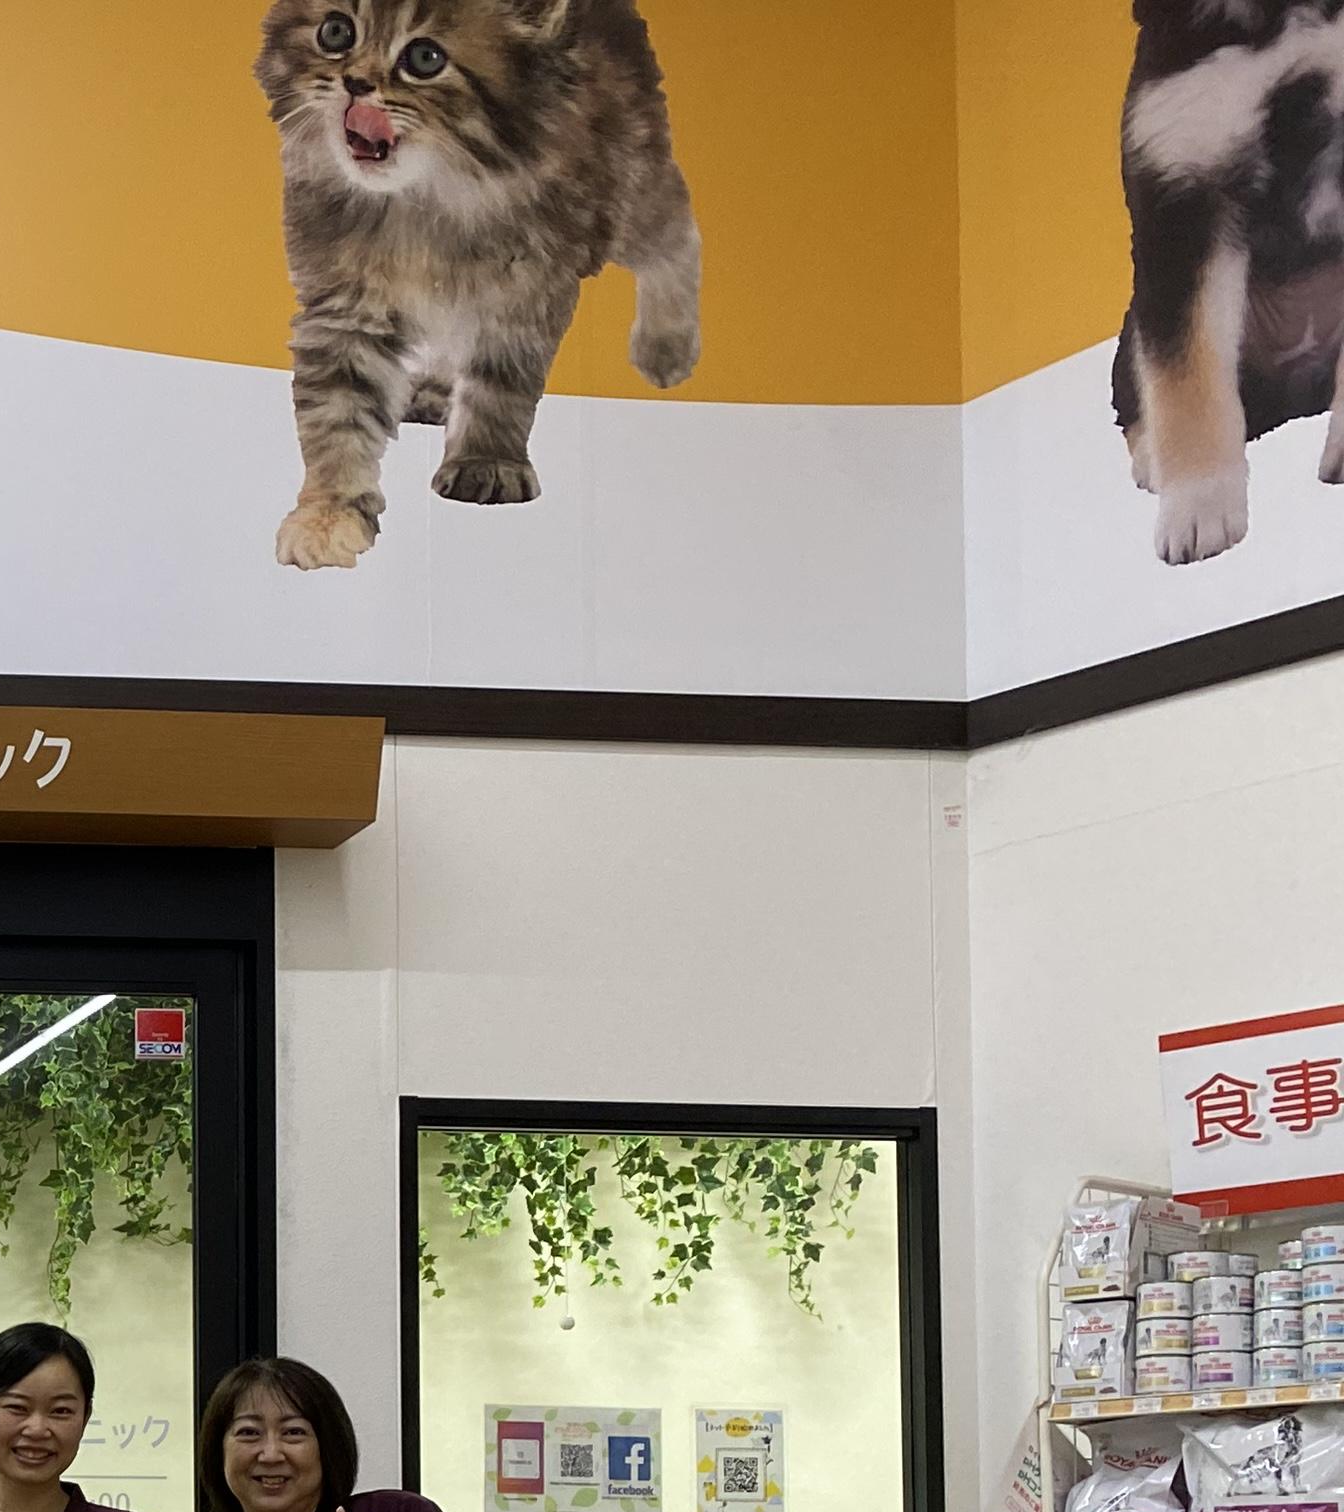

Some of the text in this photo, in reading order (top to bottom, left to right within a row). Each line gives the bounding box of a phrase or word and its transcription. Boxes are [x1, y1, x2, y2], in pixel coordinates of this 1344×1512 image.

[139, 1043, 181, 1054] SECOM
[1185, 1058, 1344, 1147] 食事
[608, 1484, 654, 1496] facebook
